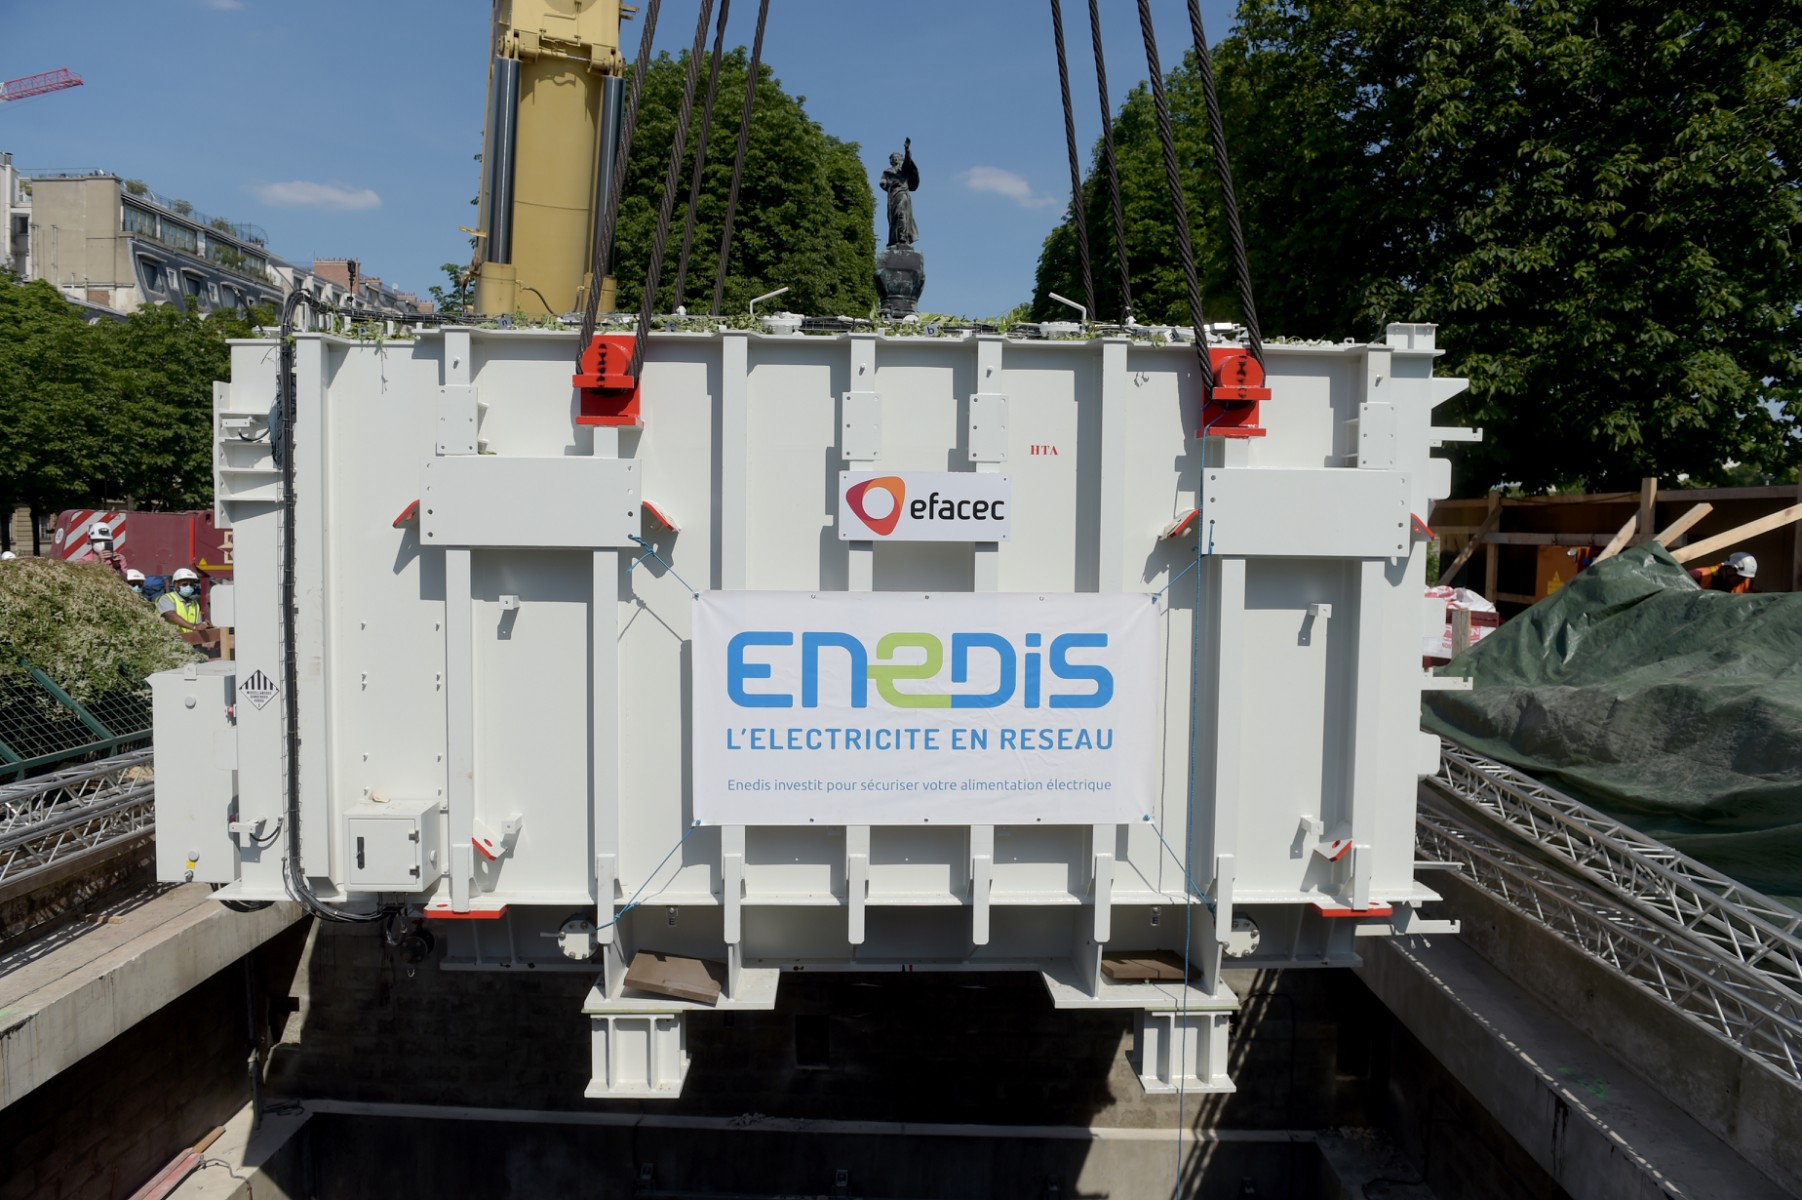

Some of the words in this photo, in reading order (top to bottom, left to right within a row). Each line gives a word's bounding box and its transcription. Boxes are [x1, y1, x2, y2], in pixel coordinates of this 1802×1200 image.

[926, 326, 935, 335] b
[1030, 444, 1058, 456] HTA
[910, 491, 1005, 521] efacec
[951, 728, 988, 751] EN
[999, 728, 1114, 751] RESEAU
[727, 779, 771, 791] Enedis
[774, 779, 823, 791] investit
[826, 781, 857, 793] pour
[860, 779, 919, 791] sécuriser
[922, 780, 958, 791] votre
[960, 779, 1043, 791] alimentation
[1046, 779, 1112, 793] électrique
